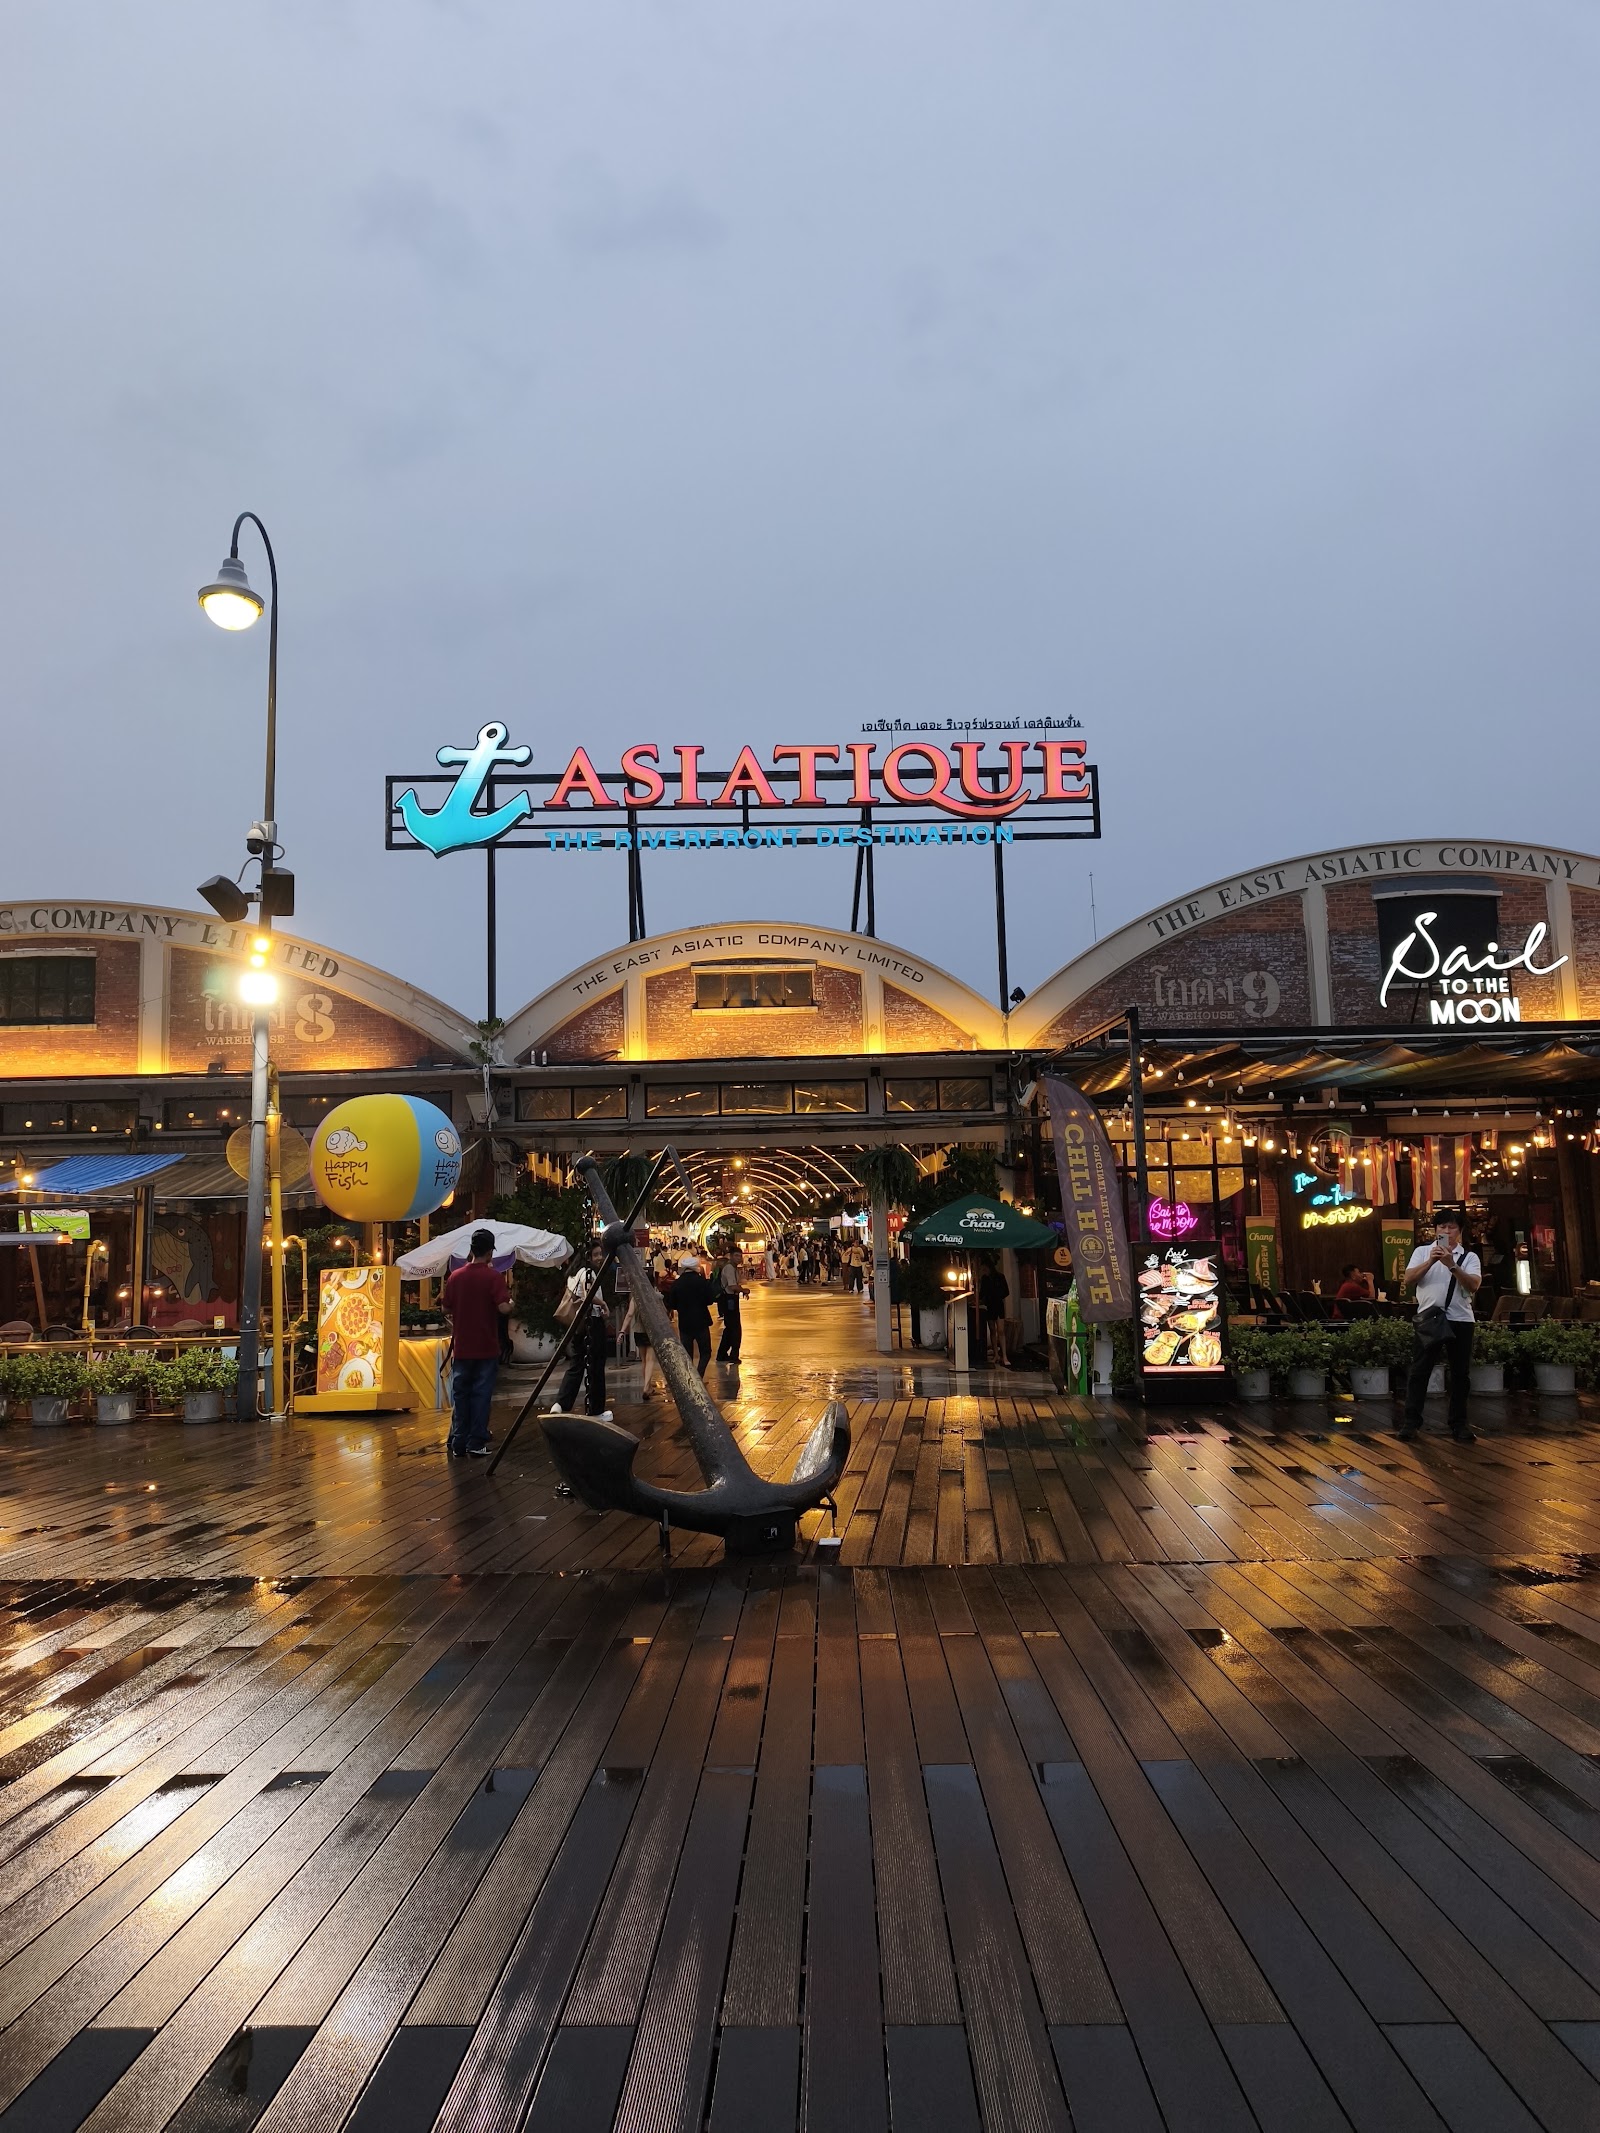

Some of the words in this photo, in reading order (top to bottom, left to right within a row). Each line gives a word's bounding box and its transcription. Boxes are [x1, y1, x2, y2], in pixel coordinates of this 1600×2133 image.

[543, 740, 1090, 820] ASIATIQUE
[545, 831, 602, 851] THE
[615, 828, 802, 850] RIVERFRONT
[816, 825, 1014, 847] DESTINATION
[1147, 900, 1206, 938] THE
[1215, 870, 1286, 909] EAST
[1305, 849, 1422, 883] ASIATIC
[1438, 847, 1580, 879] COMPANY
[30, 908, 181, 937] COMPANY
[572, 971, 608, 995] THE
[613, 949, 661, 974] EAST
[671, 935, 743, 956] ASIATIC
[758, 933, 850, 956] COMPANY
[857, 949, 924, 984] LIMITED
[1380, 911, 1569, 1008] Sail
[1242, 970, 1280, 1018] 9
[1439, 979, 1468, 995] TO
[1473, 977, 1510, 993] THE
[294, 993, 336, 1043] 8
[1157, 1010, 1235, 1020] WAREHOUSE
[1430, 997, 1521, 1025] MOON
[205, 1035, 285, 1046] WAREHSE
[324, 1159, 368, 1172] Happy
[325, 1173, 369, 1190] Fish
[959, 1218, 1006, 1230] Chang
[936, 1233, 964, 1245] Chang
[1249, 1232, 1274, 1242] Chang
[1384, 1235, 1412, 1246] Chang
[1260, 1244, 1269, 1268] BREW
[1262, 1270, 1272, 1290] OLD
